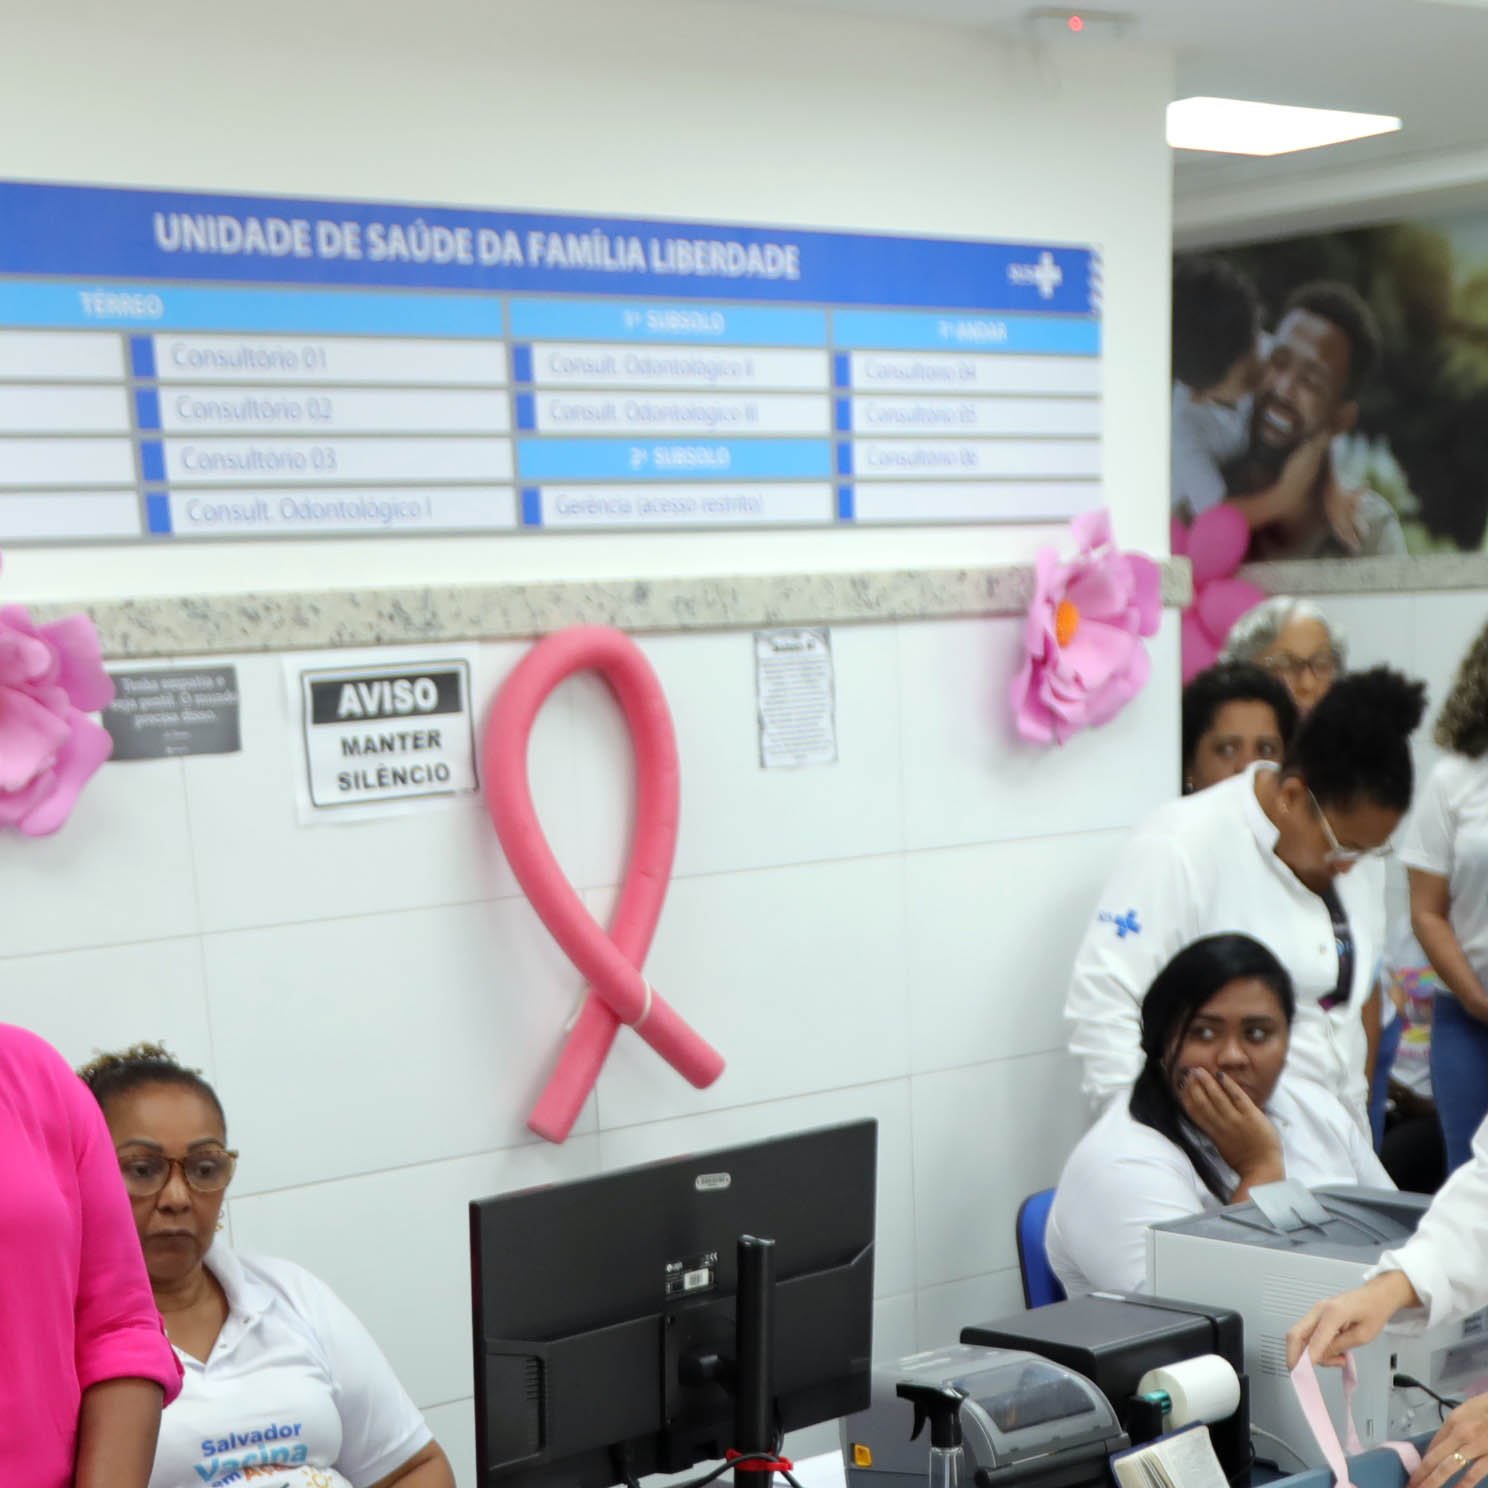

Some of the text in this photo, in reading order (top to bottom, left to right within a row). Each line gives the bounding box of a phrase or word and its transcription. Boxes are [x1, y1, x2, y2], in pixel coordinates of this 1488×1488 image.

[154, 211, 801, 281] UNIDADE DE SAÚDE DA FAMÍLIA LIBERDADE
[79, 288, 164, 320] TÉRREO
[171, 343, 327, 371] Consultório 01
[176, 395, 334, 423] Consultório 02
[181, 446, 338, 475] Consultório 03
[186, 498, 269, 525] Consult.
[279, 495, 423, 526] Odontológico
[555, 494, 632, 517] Gerência
[337, 677, 438, 719] AVISO
[340, 729, 442, 757] MANTER
[338, 762, 451, 791] SILÊNCIO
[201, 1423, 302, 1457] Salvador
[193, 1443, 308, 1483] Vacina
